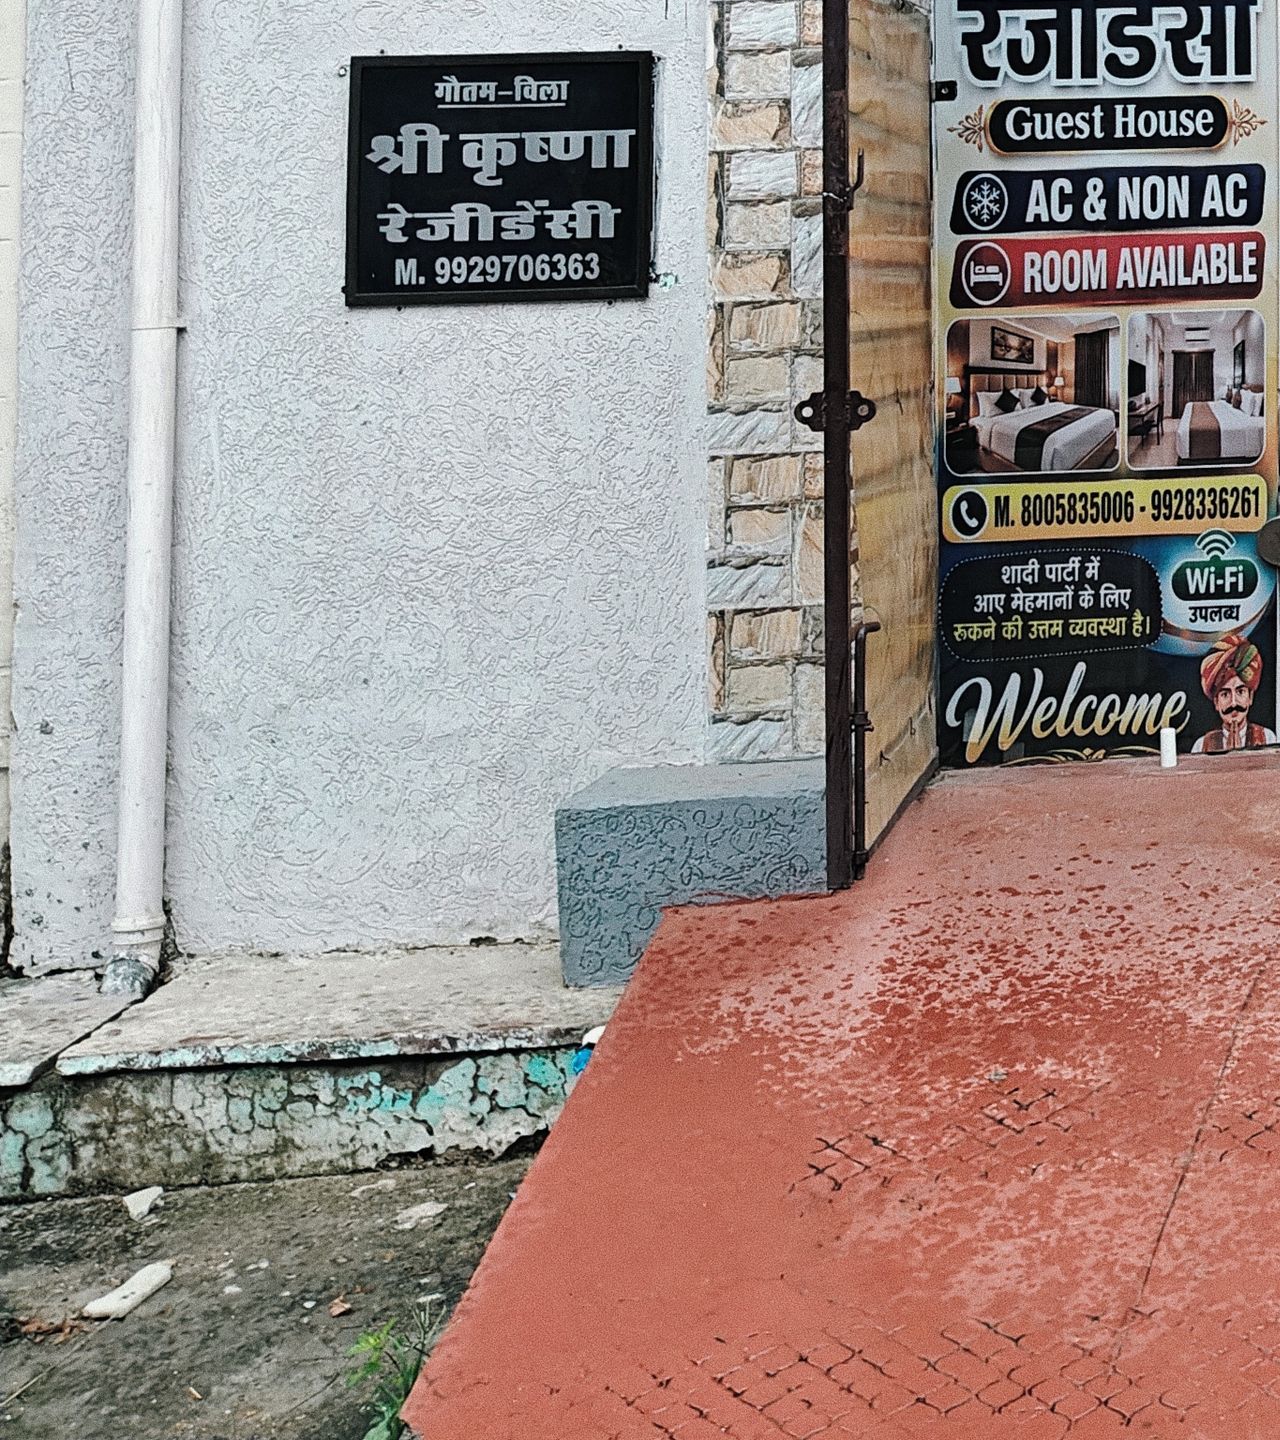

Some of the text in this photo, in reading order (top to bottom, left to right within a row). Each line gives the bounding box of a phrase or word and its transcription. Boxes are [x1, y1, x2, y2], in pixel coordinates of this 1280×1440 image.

[1005, 104, 1215, 141] Guest House
[364, 122, 636, 186] श्री कृष्णा
[1025, 173, 1248, 223] AC & NON AC
[376, 199, 622, 243] रेजीडेंसी
[394, 252, 600, 286] M. 9929706363
[1023, 241, 1258, 295] ROOM AVAILABLE
[994, 495, 1015, 528] M.
[1021, 490, 1135, 527] 8005835006
[1150, 486, 1260, 522] 9928336261
[1001, 555, 1101, 584] शादी पार्टी में
[1185, 564, 1244, 595] Wi-Fi
[973, 583, 1132, 614] आए मेहमानों के लिए
[1001, 614, 1023, 640] की
[1028, 619, 1064, 639] उत्तम
[1068, 617, 1128, 637] व्यवस्था
[945, 661, 1191, 764] Welcome
